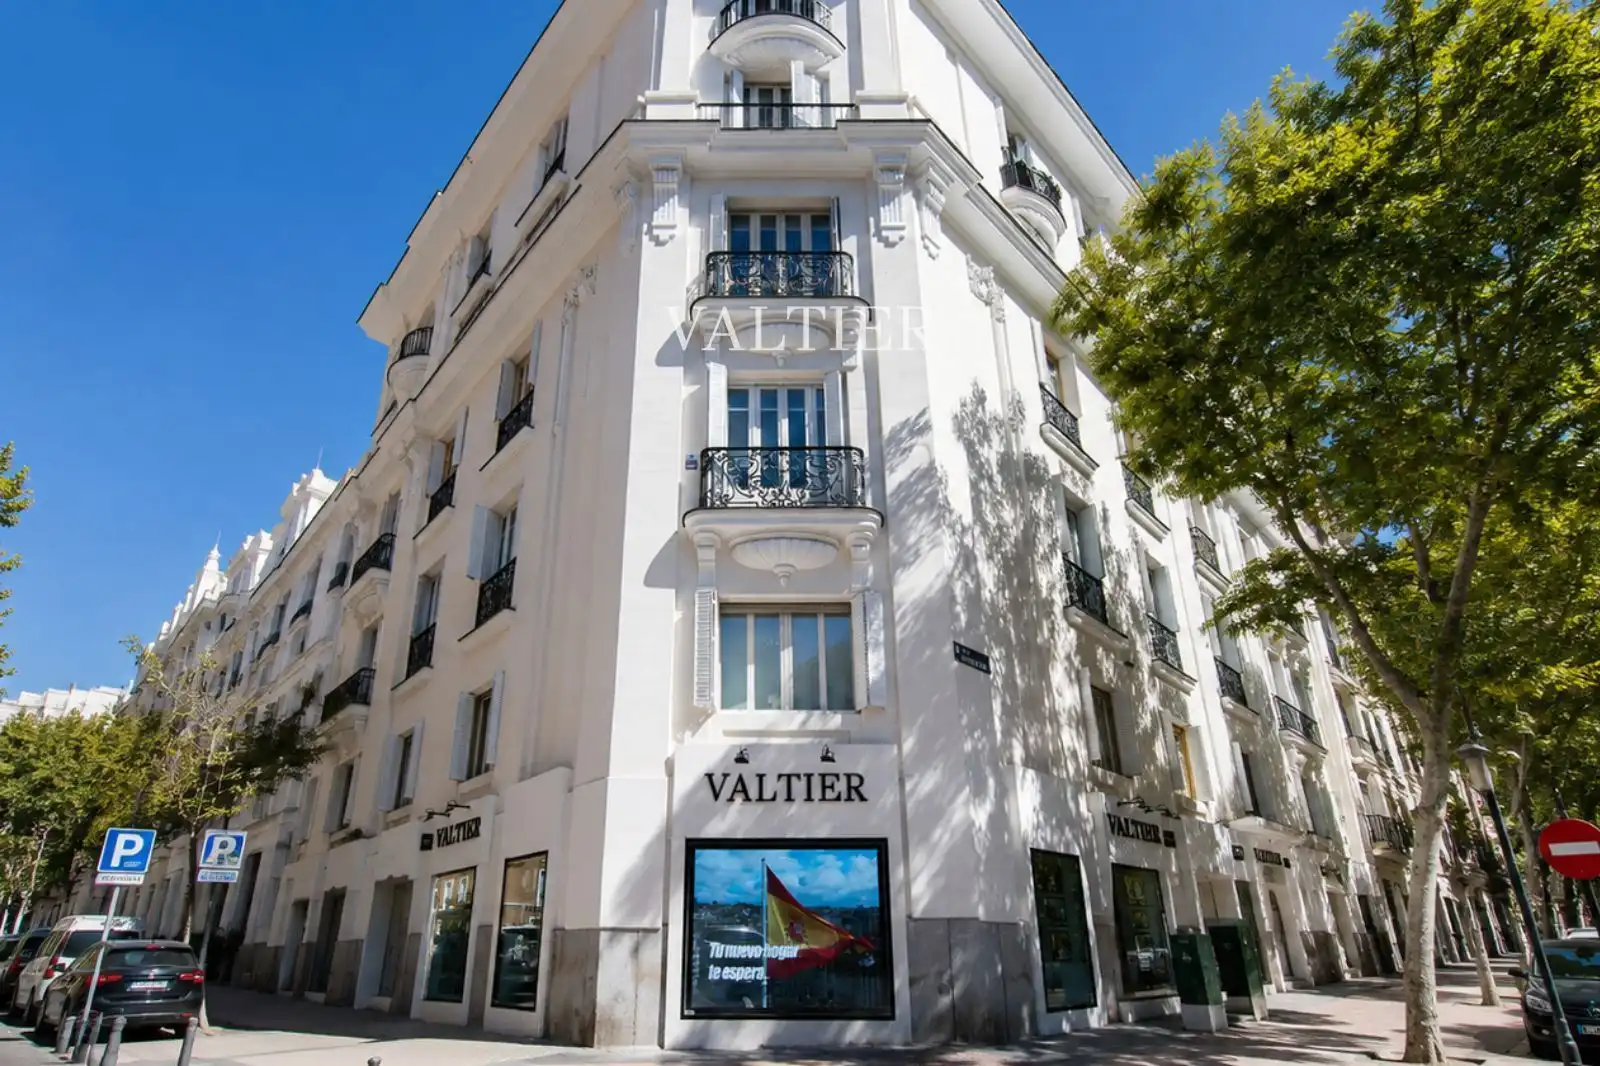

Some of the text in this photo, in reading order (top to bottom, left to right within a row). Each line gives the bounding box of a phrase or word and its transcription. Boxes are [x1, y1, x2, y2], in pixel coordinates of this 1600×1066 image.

[704, 772, 869, 803] VALTIER
[436, 816, 482, 849] VALTIER
[1107, 812, 1162, 845] VALTIER
[110, 833, 144, 868] P
[709, 942, 800, 961] Tu nuevo hogar
